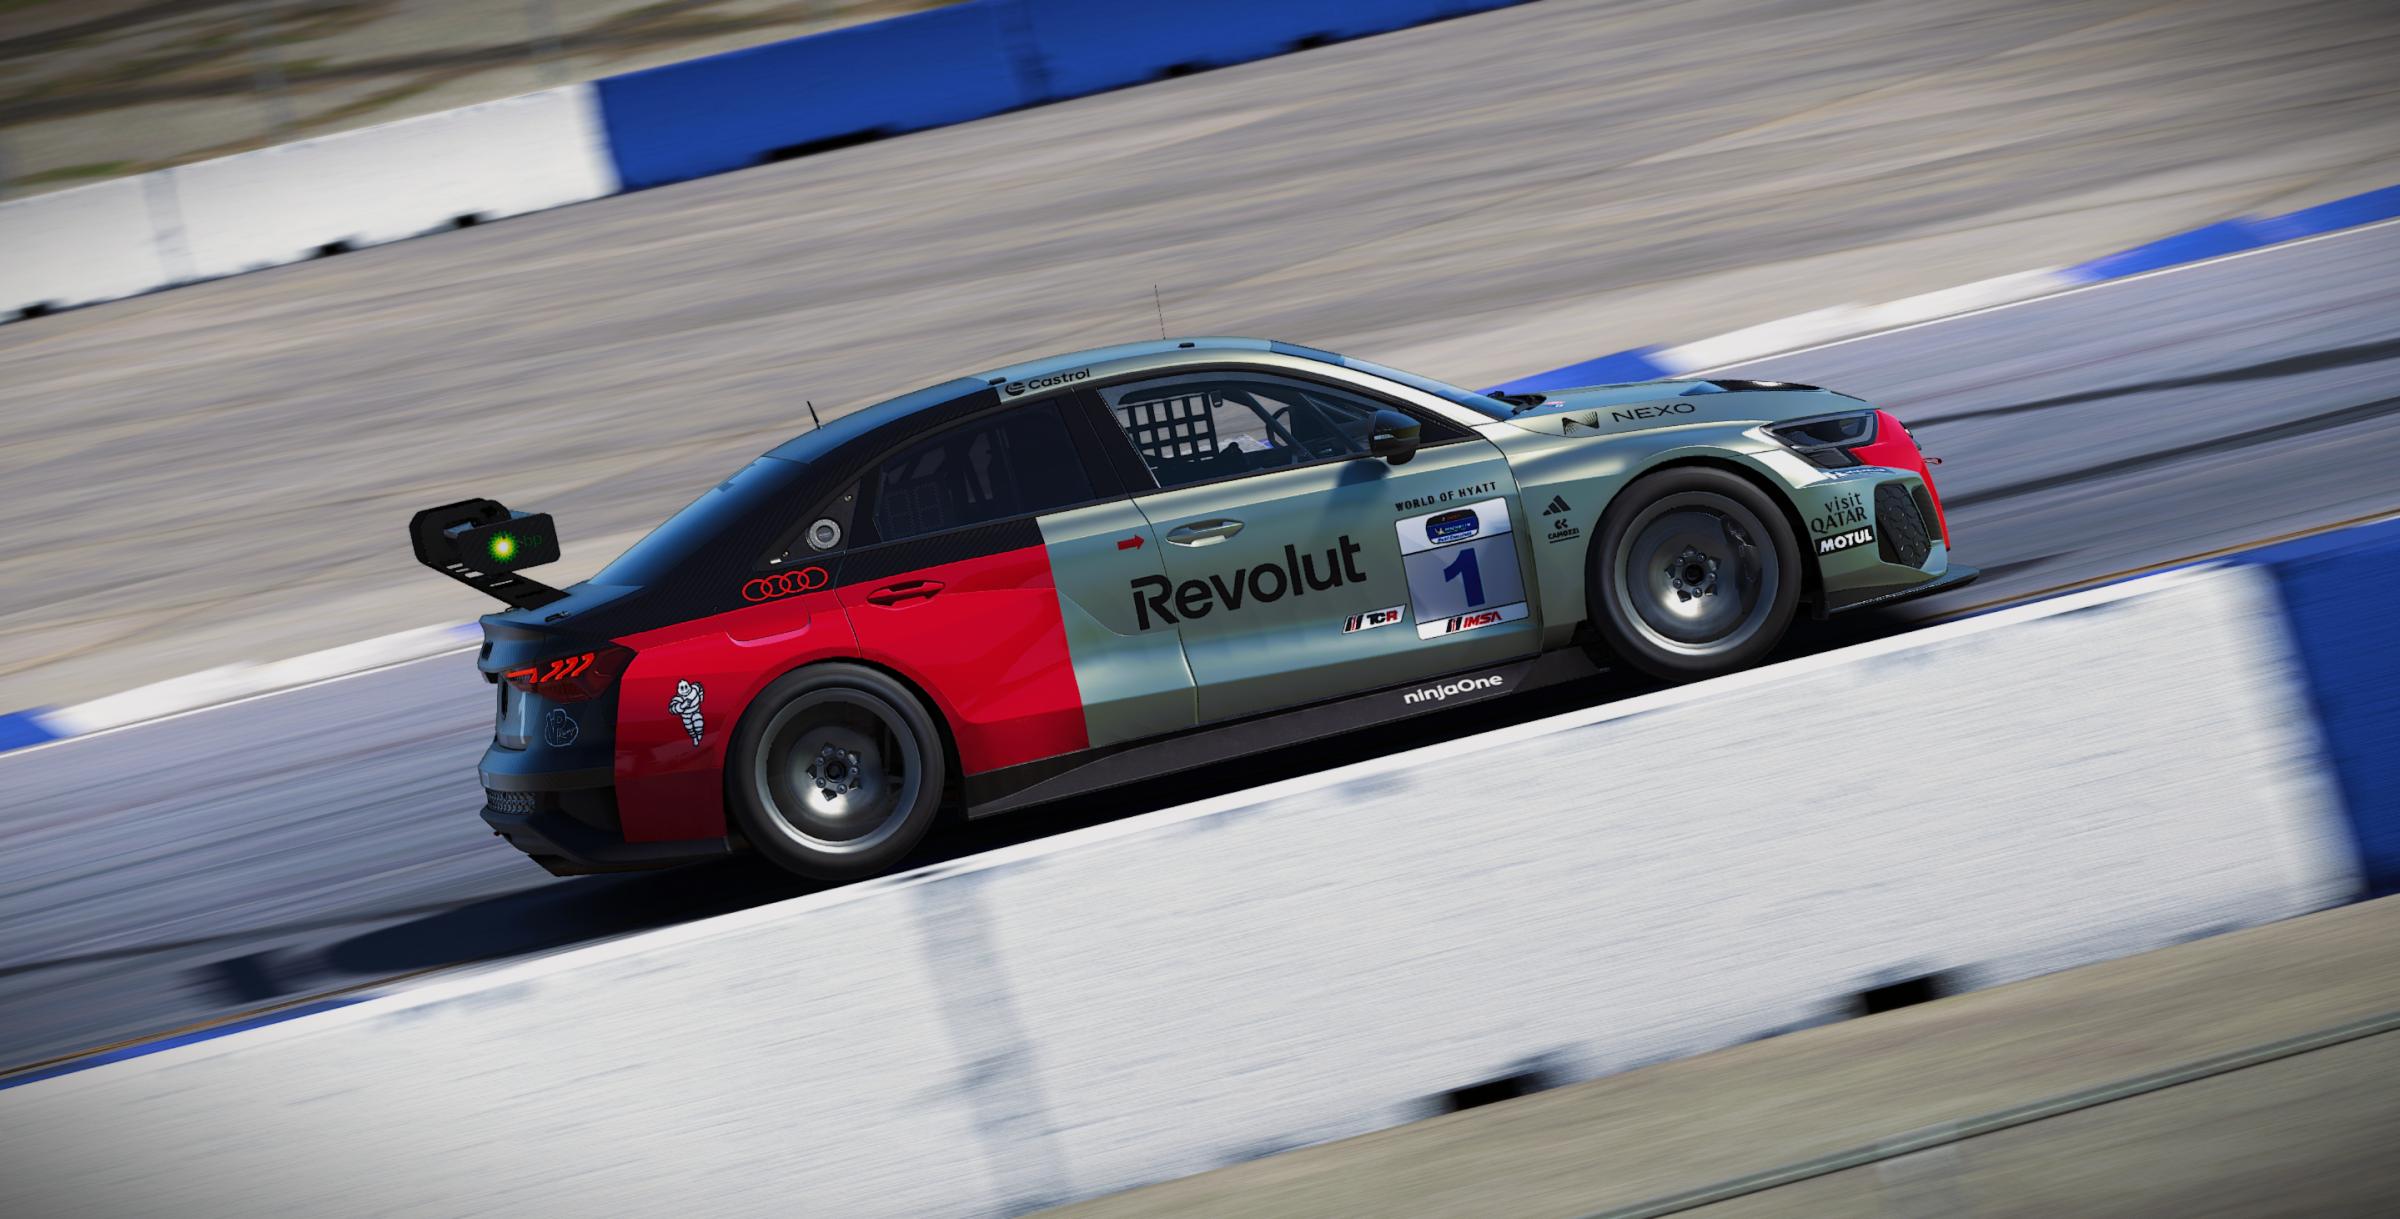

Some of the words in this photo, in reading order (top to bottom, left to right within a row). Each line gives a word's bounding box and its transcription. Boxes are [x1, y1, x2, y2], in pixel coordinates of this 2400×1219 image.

[1028, 368, 1090, 390] Castrol
[1612, 403, 1696, 423] NEXO
[1395, 495, 1435, 512] WORLD
[1440, 490, 1455, 502] OF
[1458, 481, 1497, 498] HYATT
[1824, 491, 1863, 513] visit
[1811, 506, 1868, 534] QATAR
[1820, 528, 1873, 553] MOTUL
[1130, 535, 1368, 632] Revolut
[1442, 547, 1486, 608] 1
[1366, 610, 1399, 626] TCR
[1463, 610, 1503, 629] IMSA
[1403, 675, 1504, 705] ninjaOne
